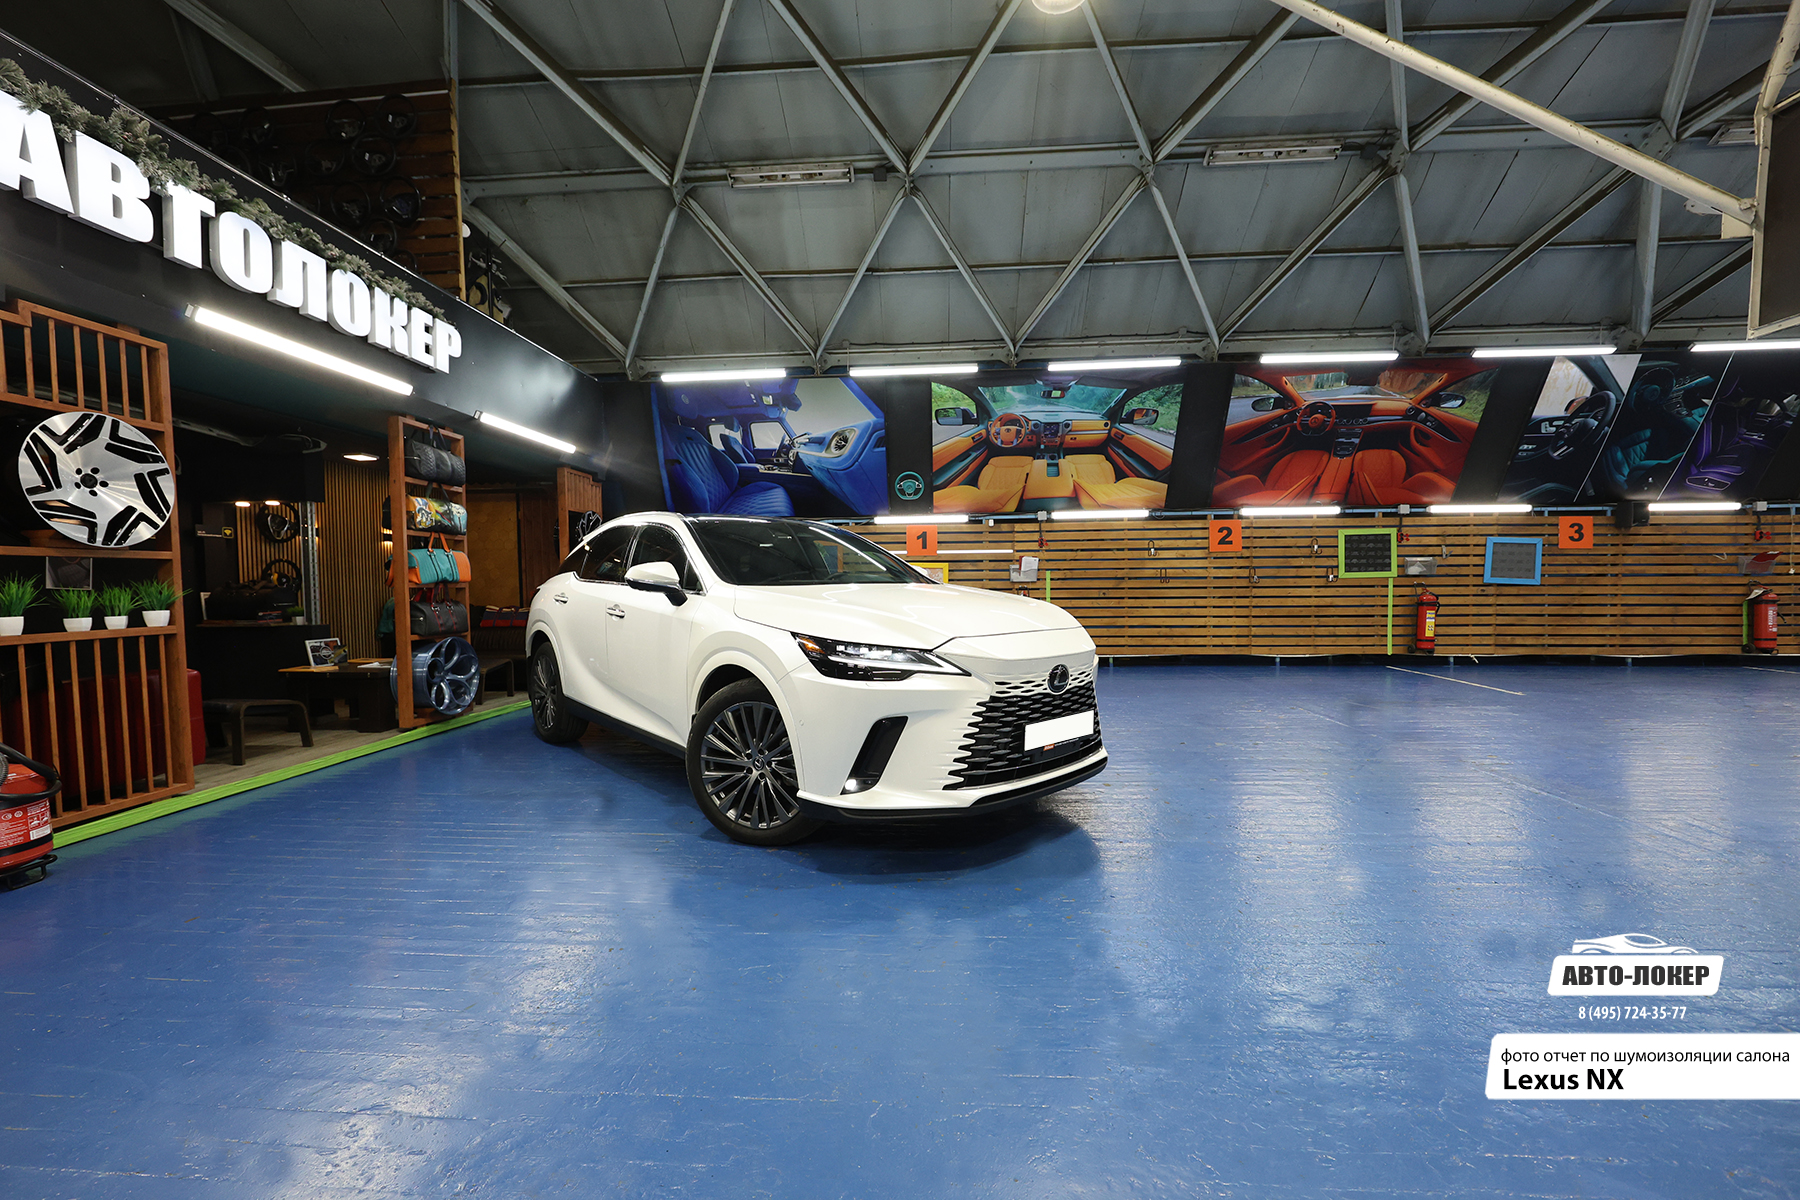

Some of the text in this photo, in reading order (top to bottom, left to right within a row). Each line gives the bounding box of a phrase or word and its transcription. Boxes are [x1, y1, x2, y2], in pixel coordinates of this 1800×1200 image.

[0, 89, 463, 374] АВТОЛОКЕР
[916, 531, 928, 550] 1
[1217, 526, 1234, 546] 2
[1568, 522, 1585, 542] 3
